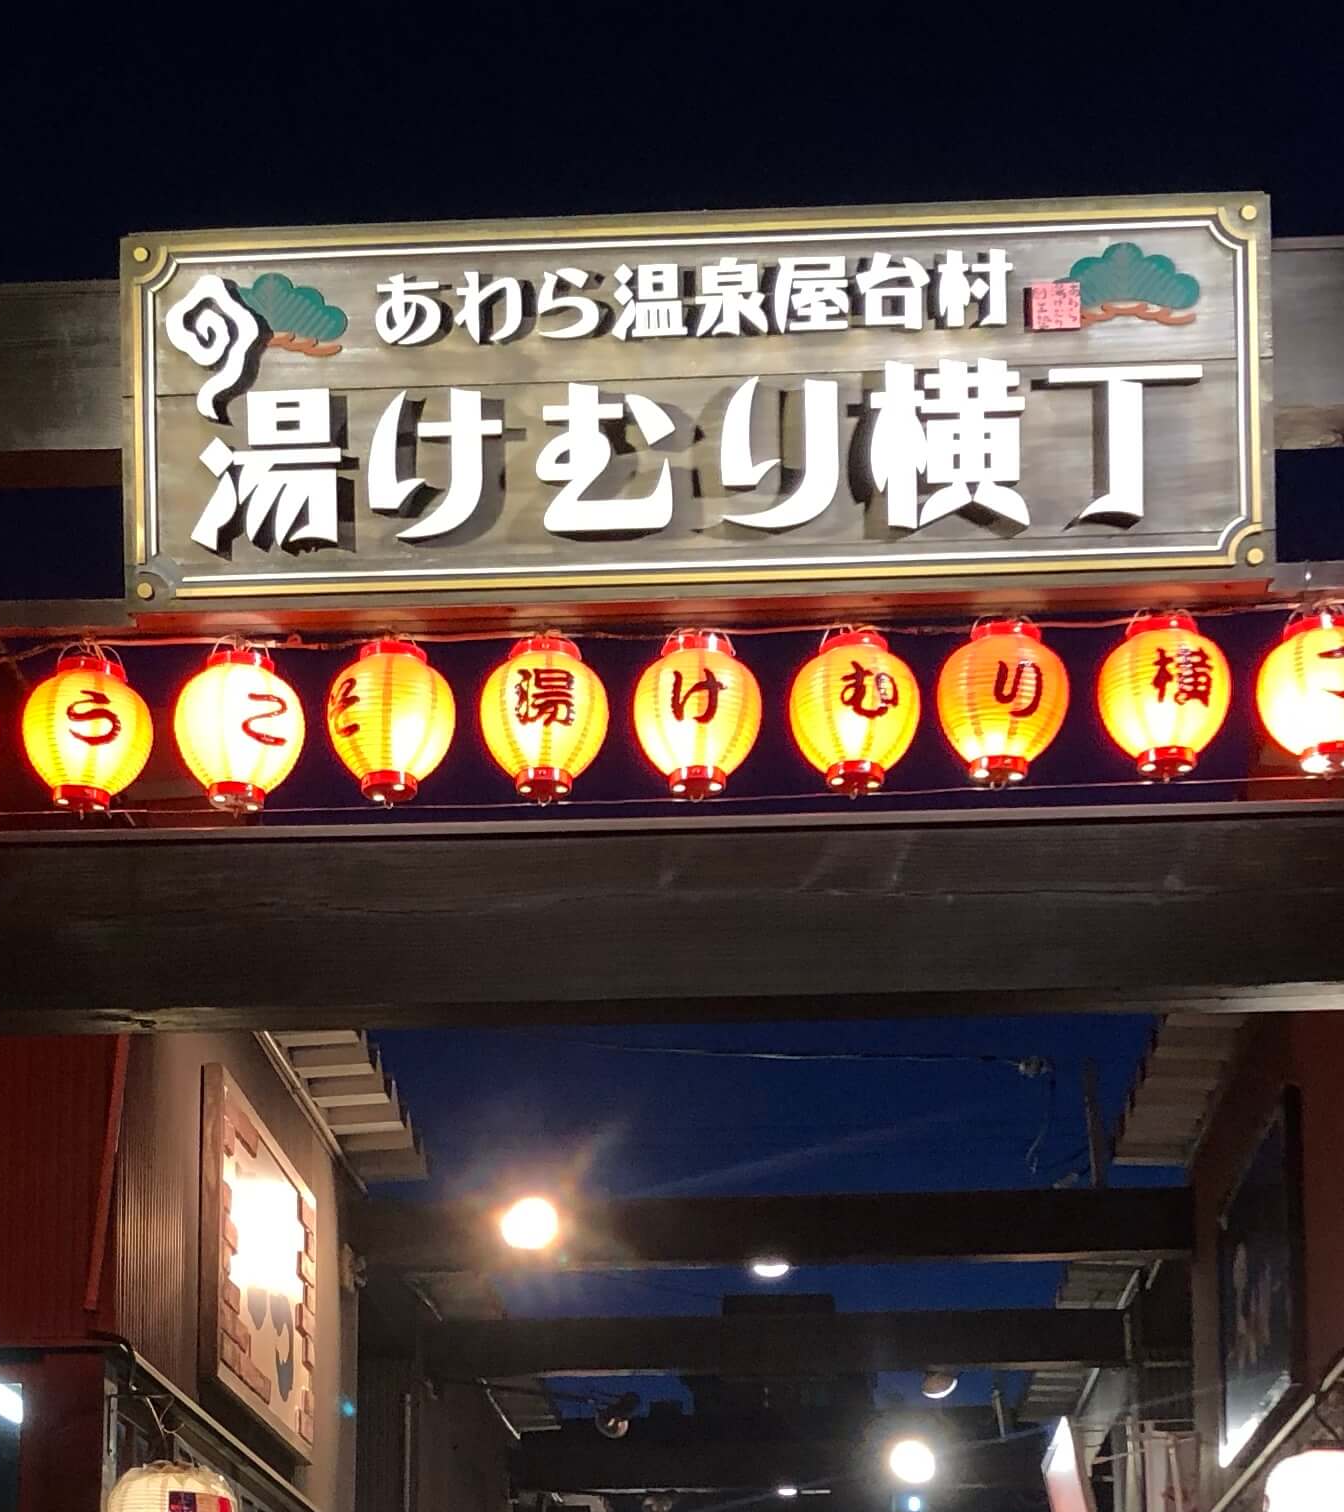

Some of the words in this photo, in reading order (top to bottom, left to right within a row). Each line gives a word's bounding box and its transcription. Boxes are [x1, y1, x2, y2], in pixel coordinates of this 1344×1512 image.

[375, 248, 1014, 347] あわら温泉屋台村
[196, 359, 1204, 553] 湯けむり横丁
